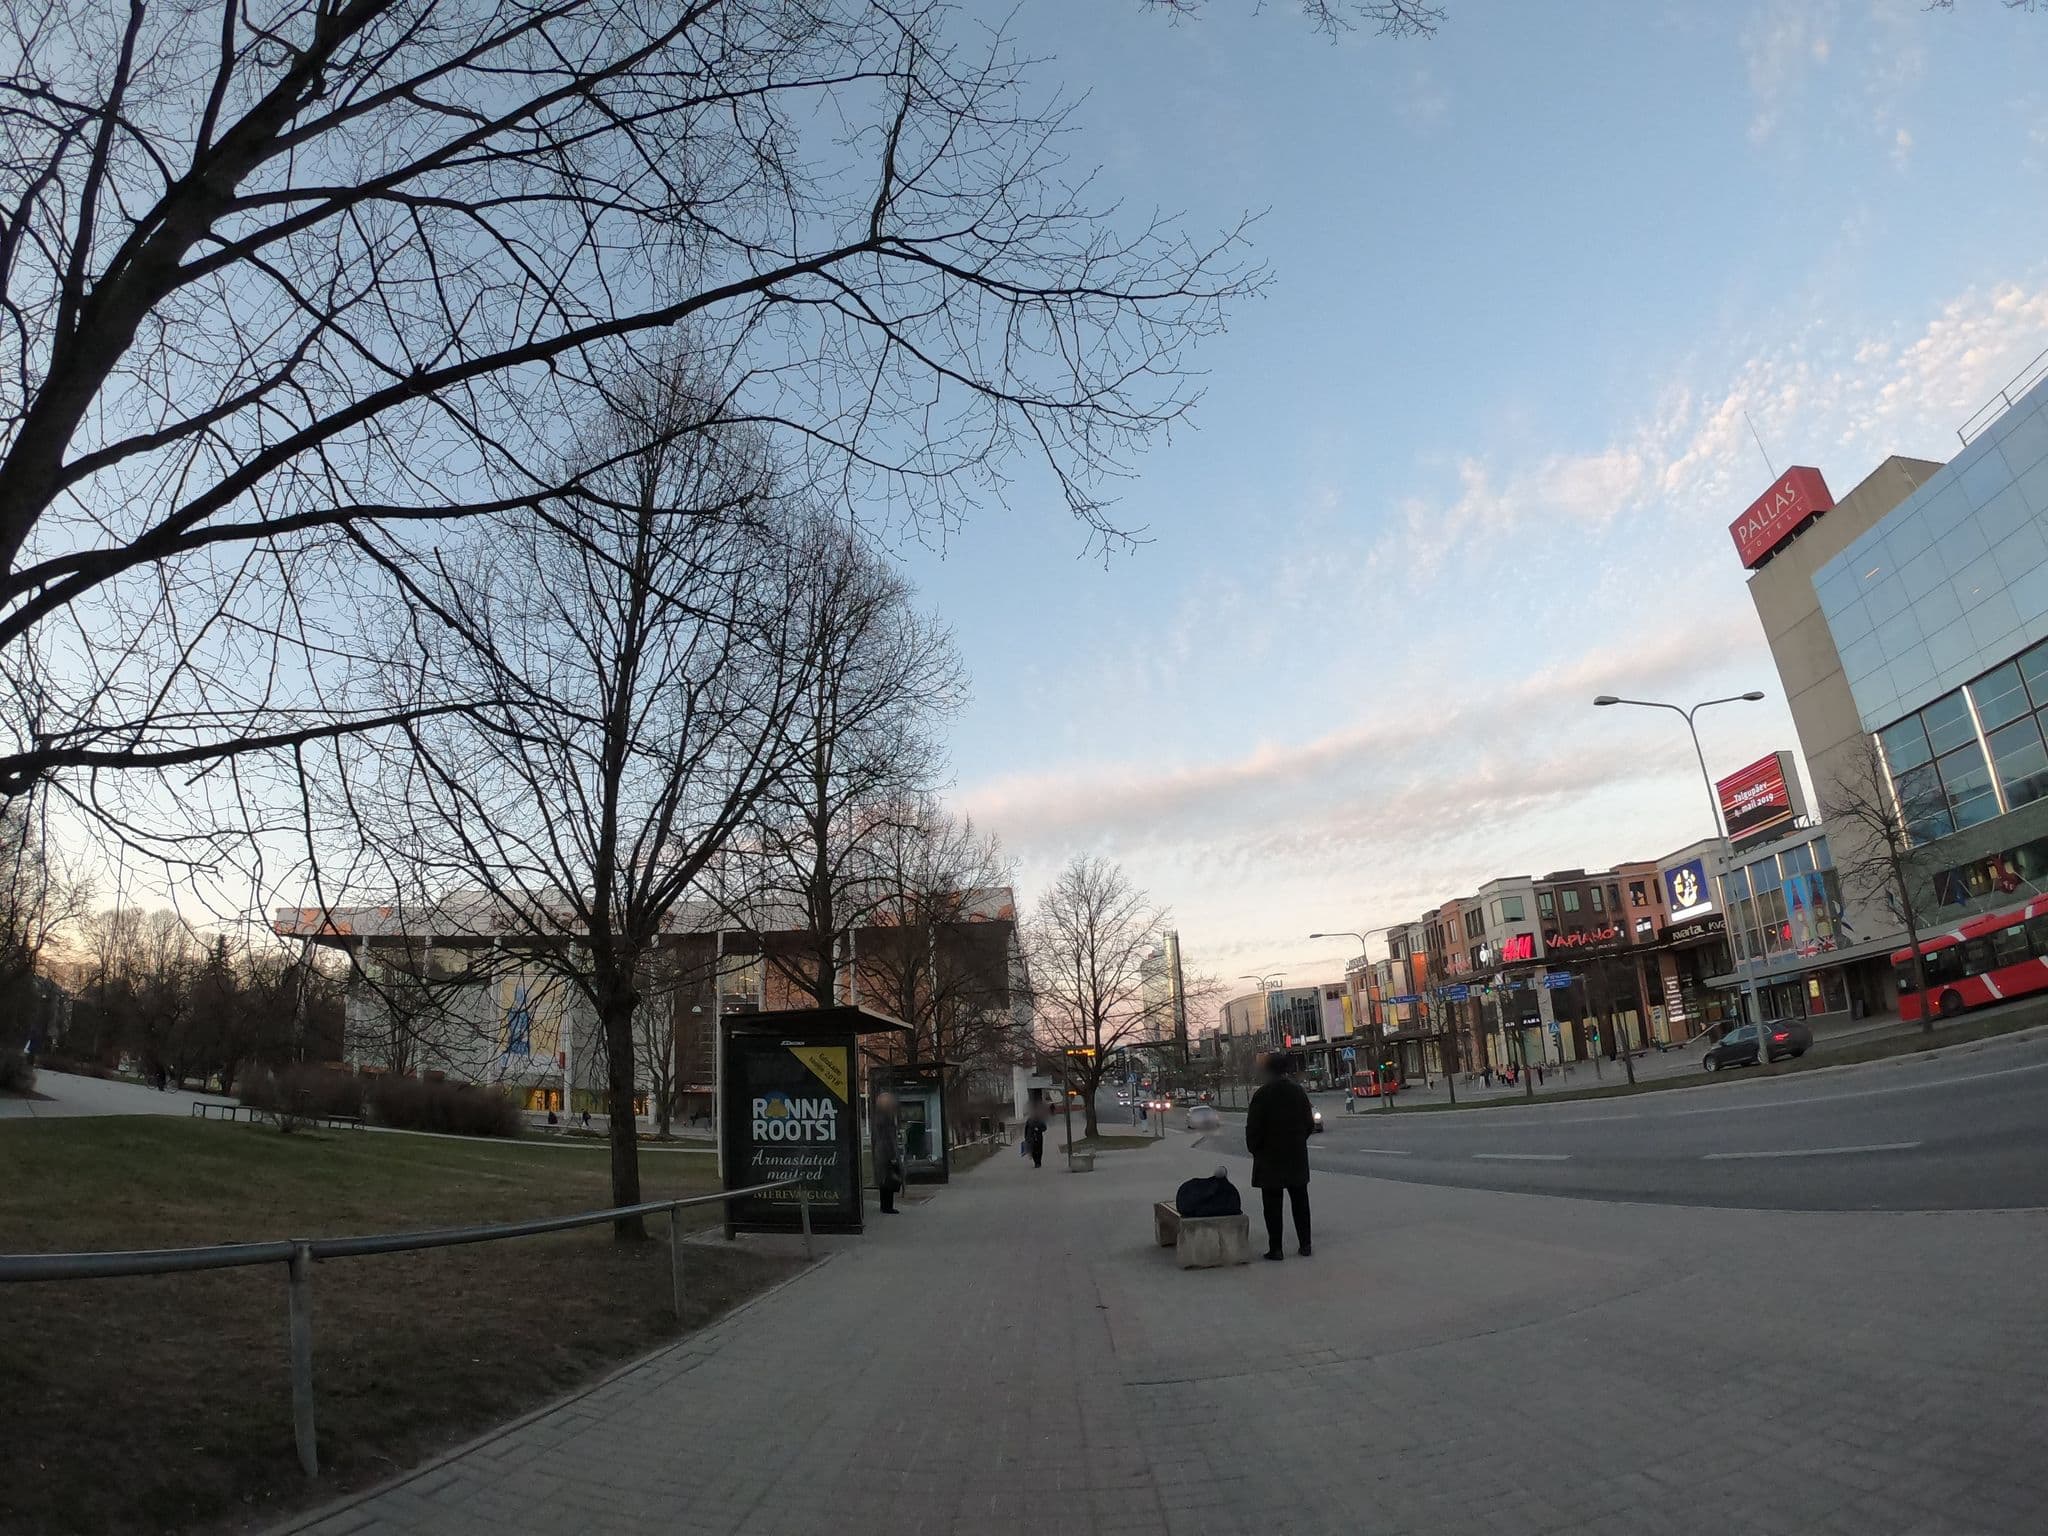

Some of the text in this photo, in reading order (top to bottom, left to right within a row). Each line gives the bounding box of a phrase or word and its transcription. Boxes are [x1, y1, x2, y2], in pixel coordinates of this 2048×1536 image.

[1738, 482, 1797, 544] PALLAS
[1757, 793, 1774, 805] 2019
[752, 1119, 836, 1141] ROOTSI
[751, 1148, 838, 1166] Armastatud
